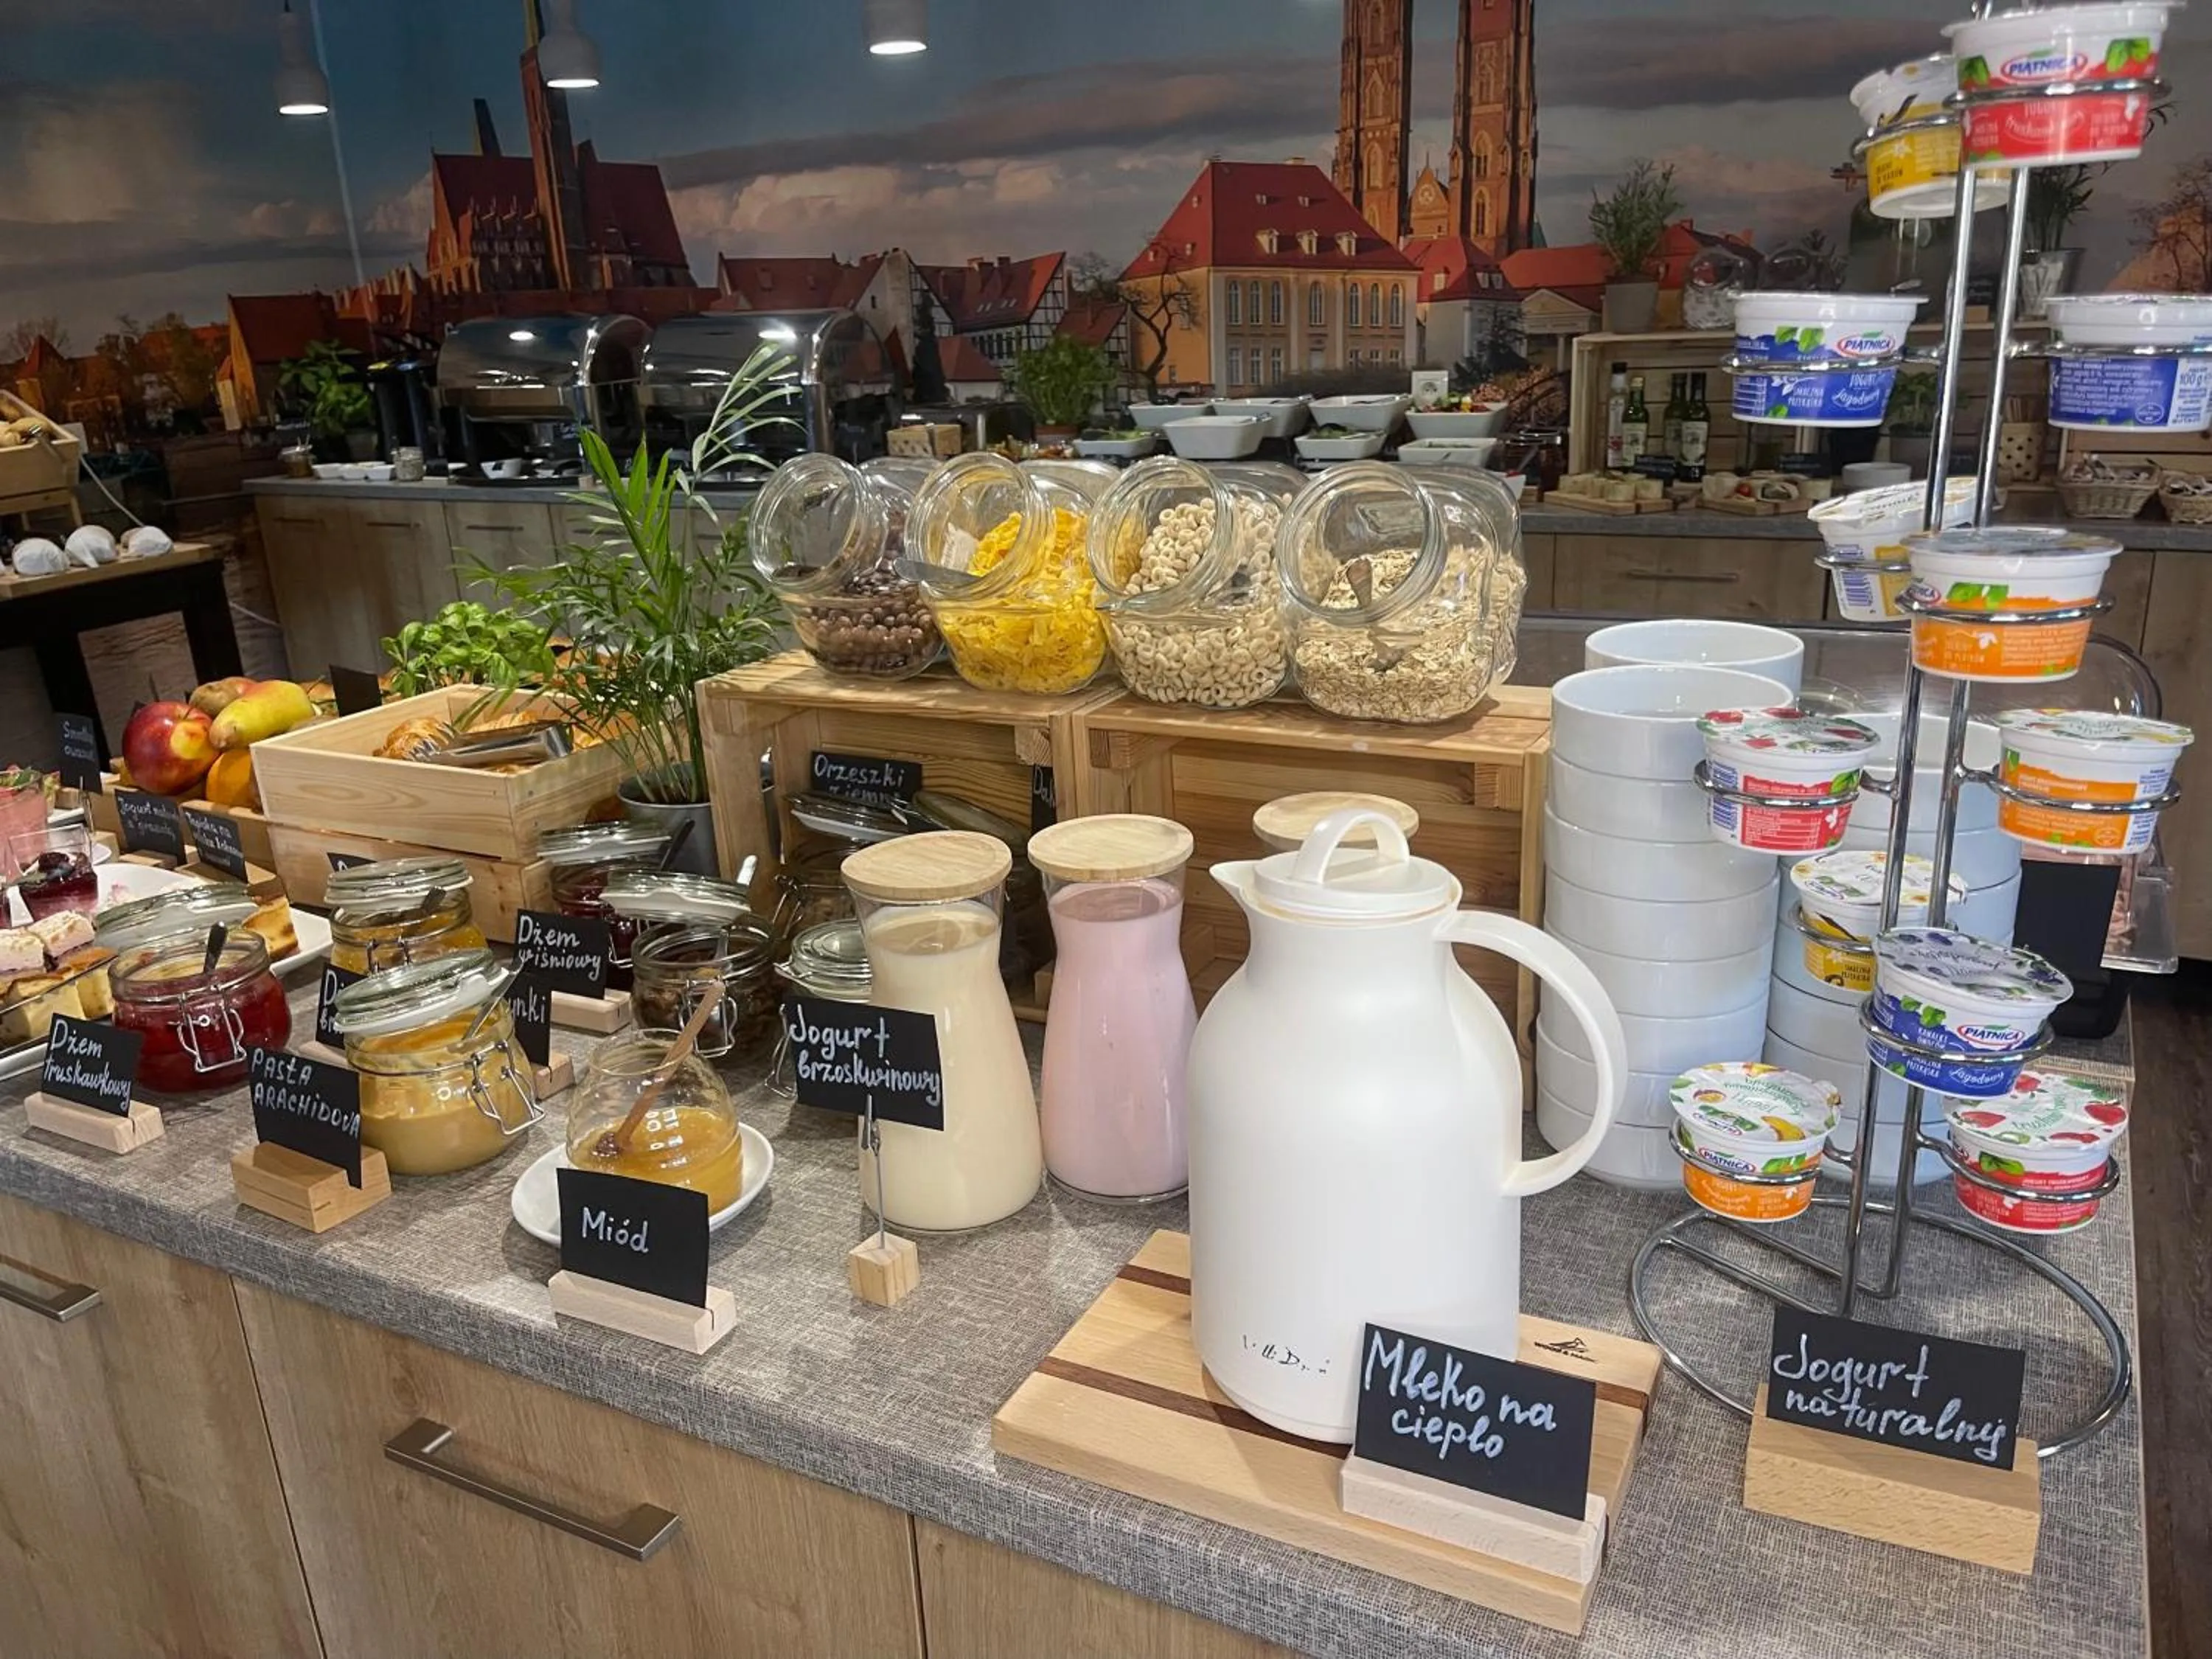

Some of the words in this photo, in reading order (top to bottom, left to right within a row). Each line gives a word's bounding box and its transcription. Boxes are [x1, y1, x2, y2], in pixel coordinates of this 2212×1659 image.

[814, 754, 905, 787] Orzeszki
[518, 914, 580, 947] Dżem
[518, 945, 602, 981] wiśniowy
[50, 1018, 103, 1058] Dżem
[789, 1004, 891, 1061] Jogurt
[1964, 1026, 2019, 1040] PIĄTNICA
[44, 1052, 132, 1111] truskawkowy
[1703, 1150, 1750, 1171] PIĄTNICA
[582, 1206, 650, 1253] Miód
[1773, 1333, 1929, 1403] Jogurt
[1499, 1394, 1557, 1431] na
[1785, 1386, 2007, 1461] naturalny
